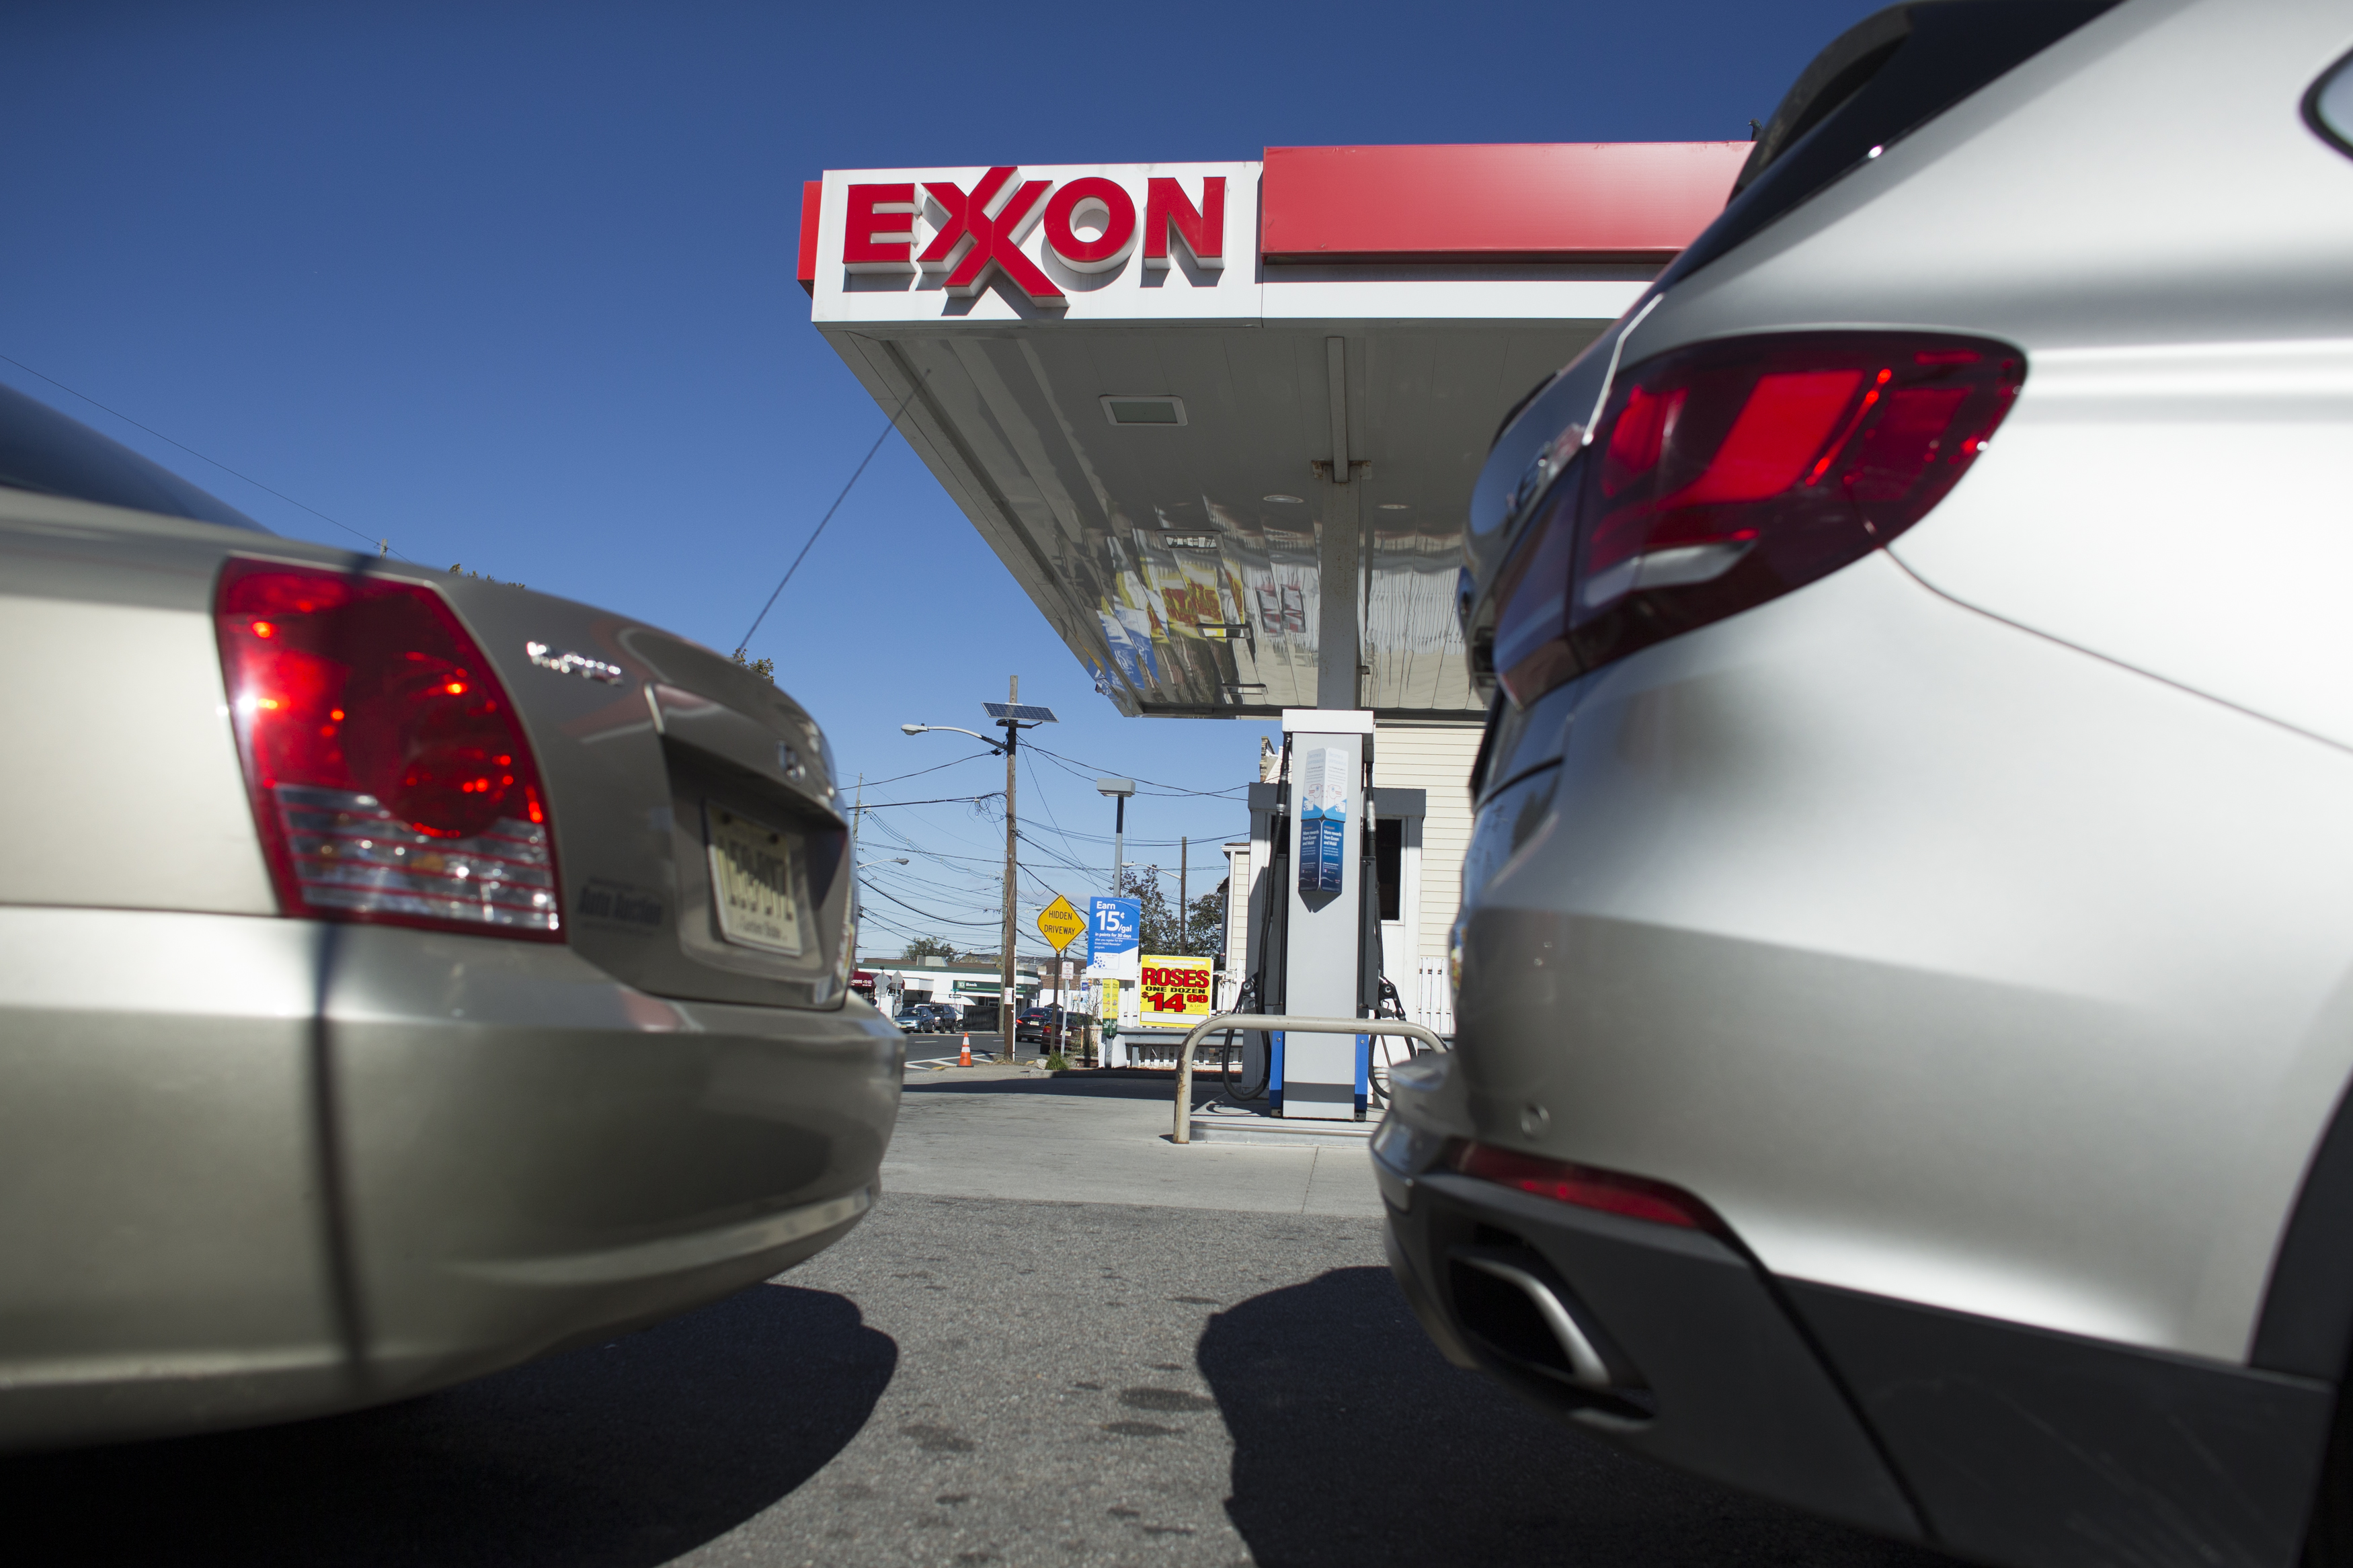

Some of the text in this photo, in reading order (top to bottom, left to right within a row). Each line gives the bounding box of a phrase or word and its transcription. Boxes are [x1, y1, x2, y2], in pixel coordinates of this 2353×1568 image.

[842, 167, 1228, 304] EXXON
[1096, 901, 1115, 910] Earn
[1049, 910, 1072, 920] HIDDEN
[1044, 924, 1076, 935] DRIVEWAY
[1142, 967, 1209, 988] ROSES
